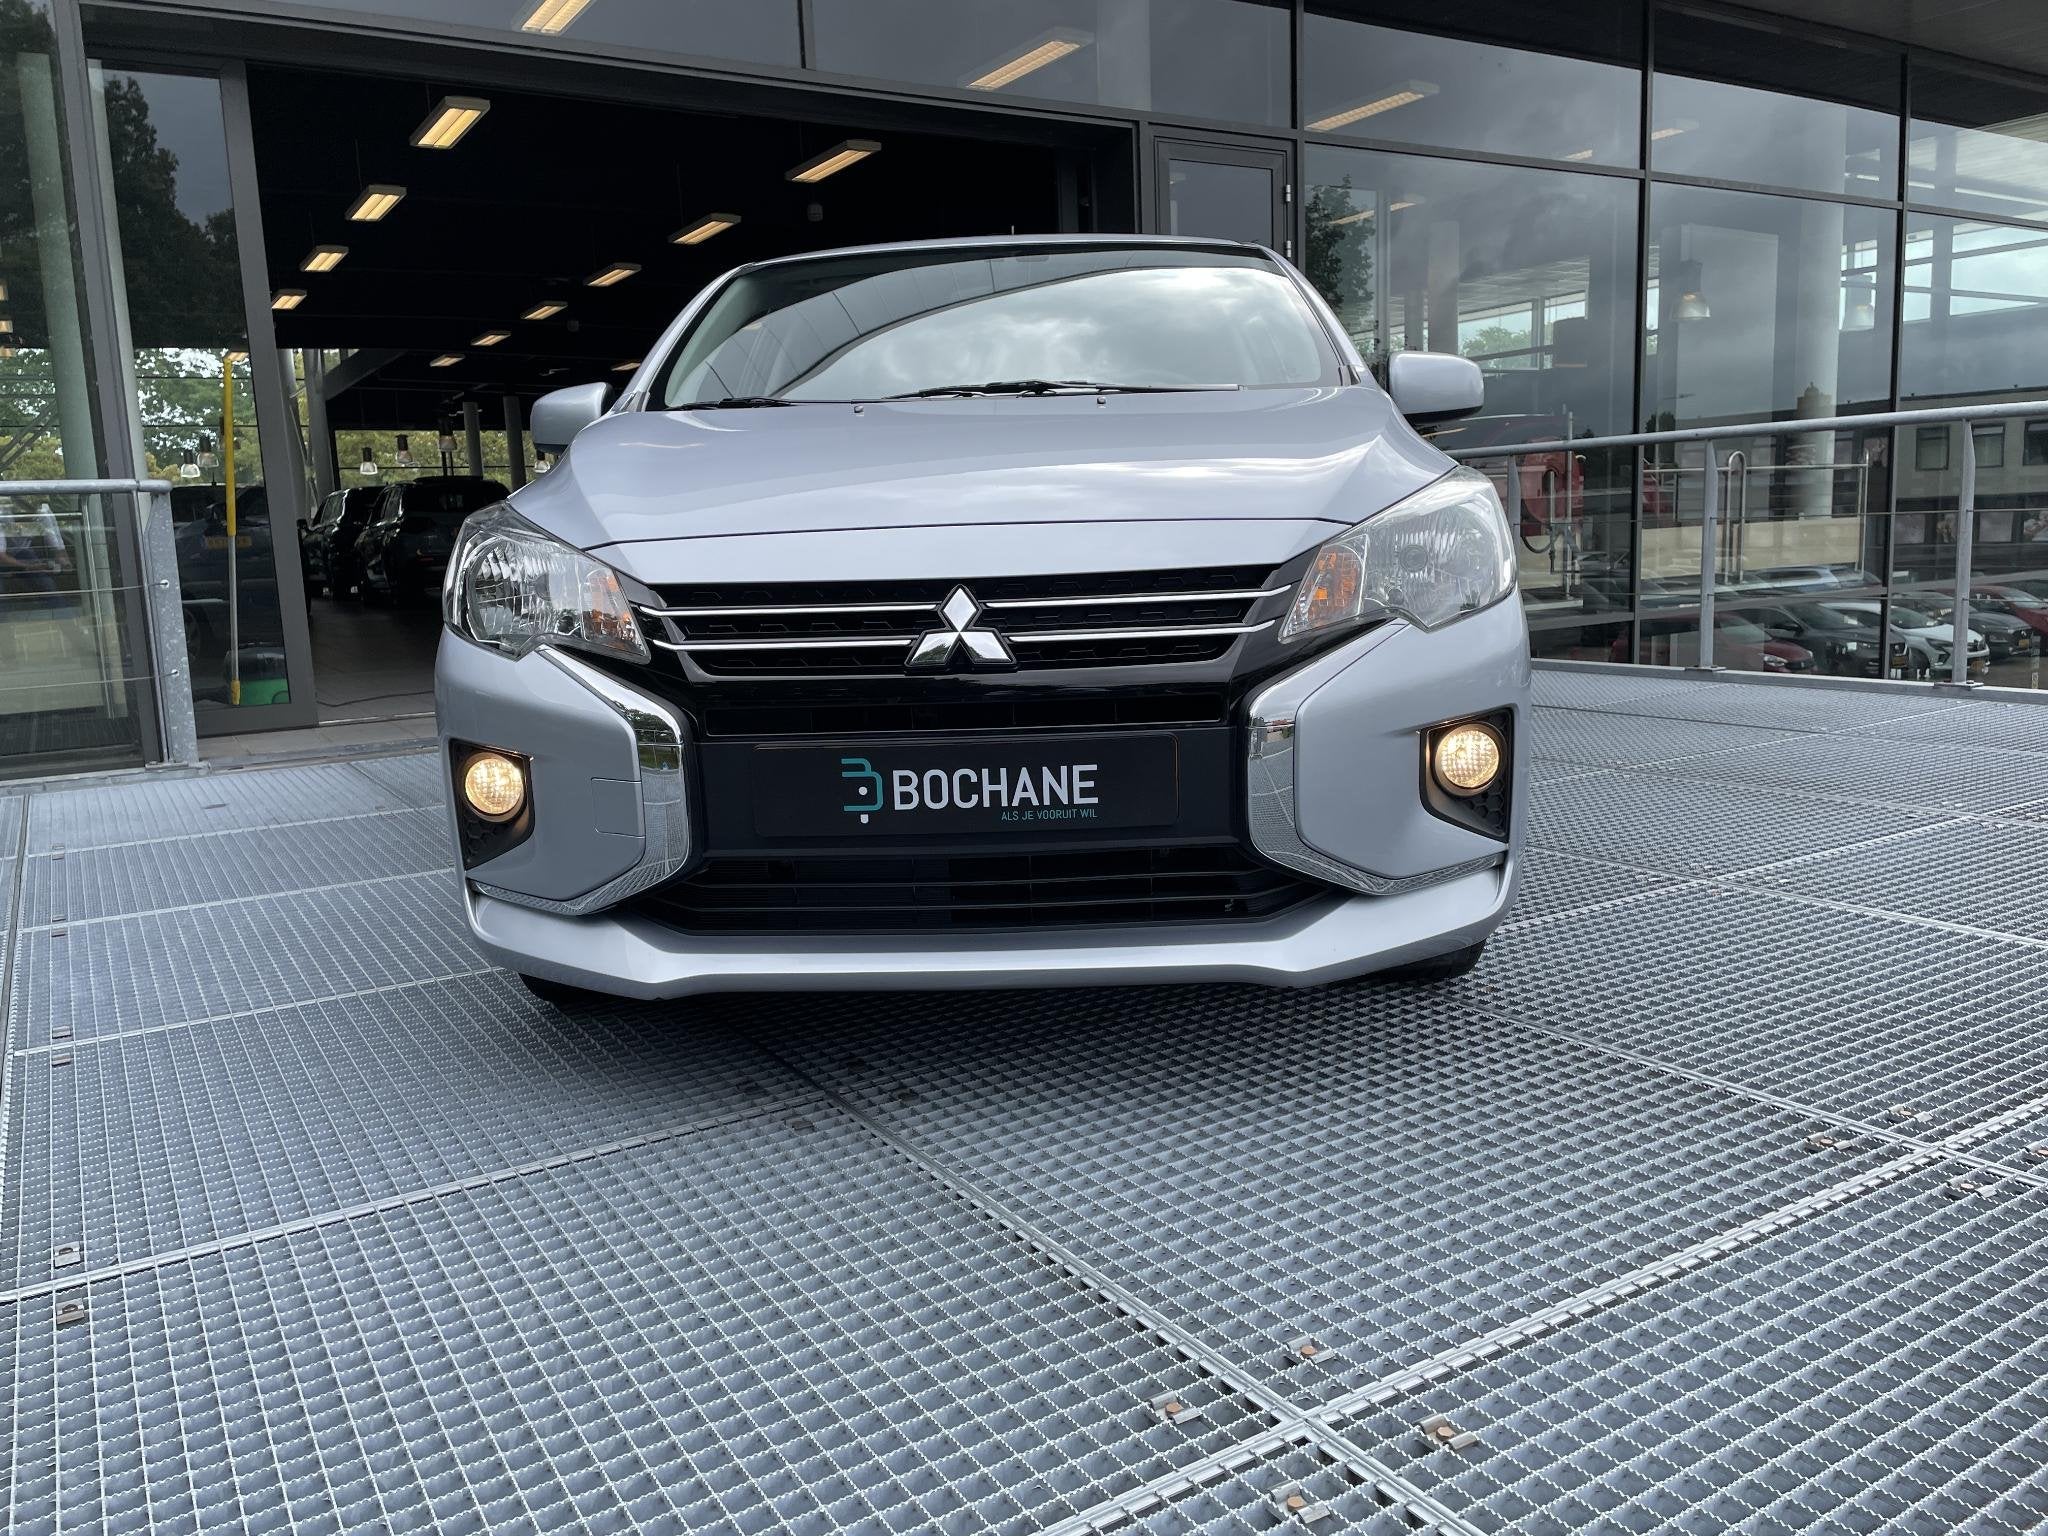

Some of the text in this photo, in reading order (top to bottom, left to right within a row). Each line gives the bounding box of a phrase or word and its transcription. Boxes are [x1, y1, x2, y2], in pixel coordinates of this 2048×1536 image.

[892, 764, 1099, 811] BOCHANE
[1001, 808, 1098, 821] ALS JE VOORUIT WIL
